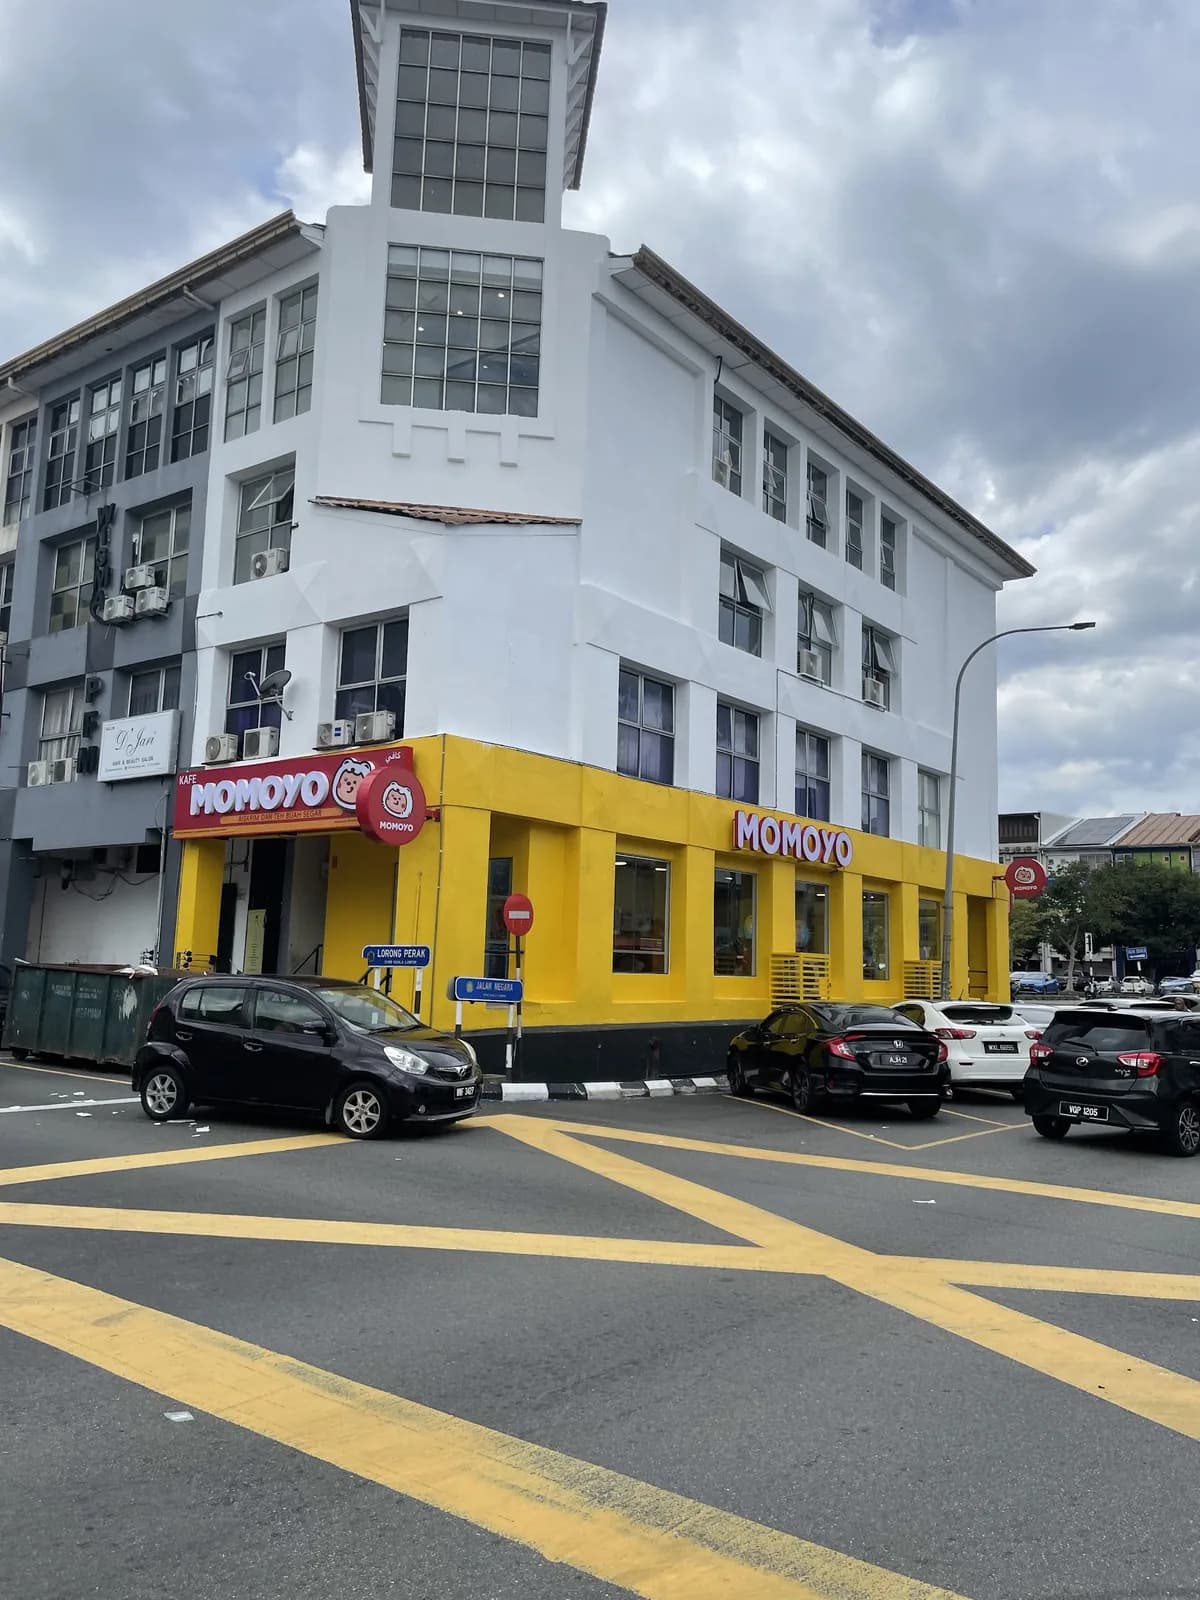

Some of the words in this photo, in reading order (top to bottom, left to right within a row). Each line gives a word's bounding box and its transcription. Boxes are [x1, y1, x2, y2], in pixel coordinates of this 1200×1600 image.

[179, 774, 197, 786] KAFE
[190, 770, 329, 816] MOMOYO
[274, 811, 285, 820] TEH
[302, 809, 322, 819] SEGAR
[379, 820, 414, 832] MOMOYO
[734, 810, 853, 868] MOMOYO
[377, 948, 402, 959] LORONG
[403, 948, 426, 959] PERAK
[476, 982, 492, 991] JALAN
[494, 983, 513, 992] NEGARA
[1083, 1107, 1098, 1117] 1205
